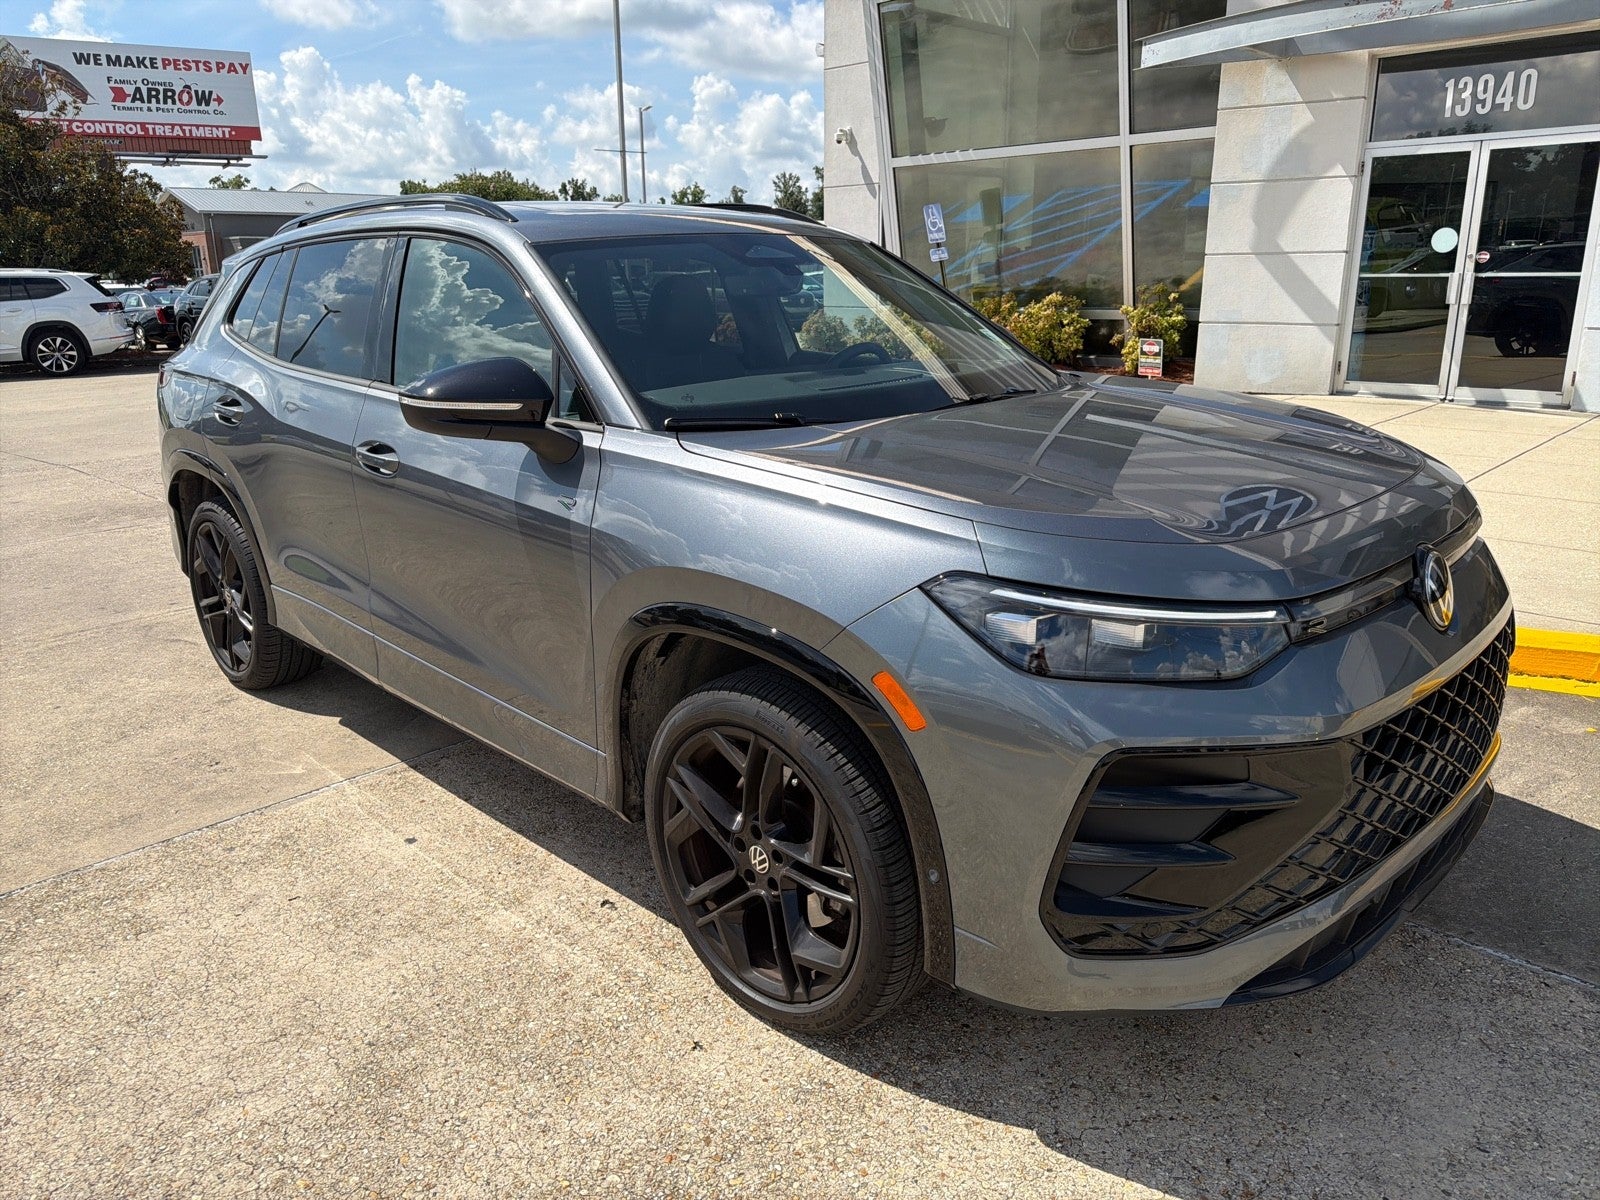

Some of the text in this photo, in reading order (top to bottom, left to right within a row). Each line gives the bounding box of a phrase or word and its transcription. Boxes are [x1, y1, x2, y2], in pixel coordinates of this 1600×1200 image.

[72, 52, 250, 75] WE MAKE PESTS PAY
[106, 76, 174, 88] FAMILY OWNED
[130, 85, 213, 107] ARROW
[1444, 68, 1539, 118] 13940
[111, 104, 144, 113] TERMITE
[146, 105, 153, 113] &
[155, 106, 175, 114] PEST
[176, 107, 211, 116] CONTROL
[71, 120, 145, 135] CONTROL
